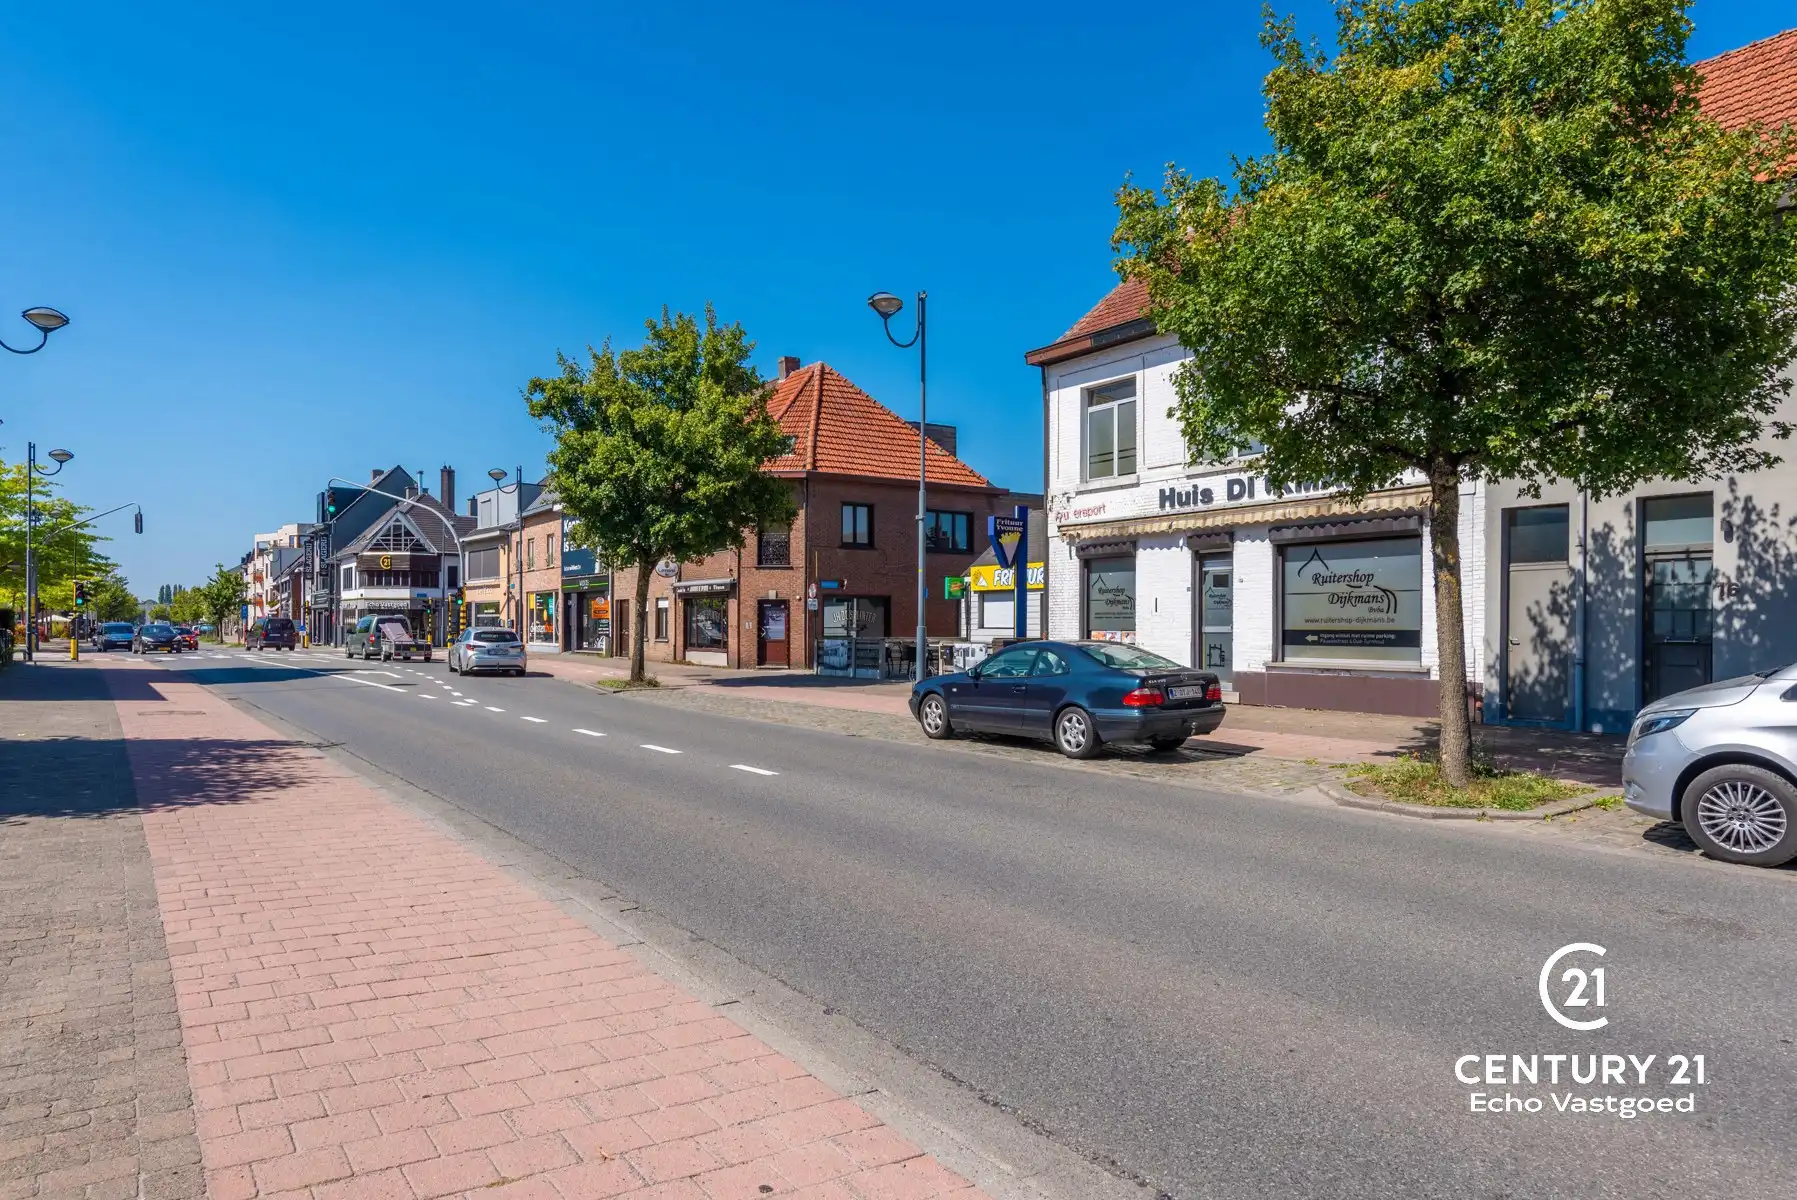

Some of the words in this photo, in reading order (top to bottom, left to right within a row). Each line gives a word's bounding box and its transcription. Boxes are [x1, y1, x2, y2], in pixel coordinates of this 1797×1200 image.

[1158, 484, 1214, 510] Huis
[996, 518, 1024, 527] Frituur
[996, 524, 1024, 532] Yvonne
[305, 543, 313, 573] SLAGERIJ
[993, 567, 1045, 587] FRIUR
[1311, 569, 1375, 587] Ruitershop
[1328, 590, 1385, 608] Dijkmans
[1304, 616, 1396, 625] www.ruitershop-dijkmans.be
